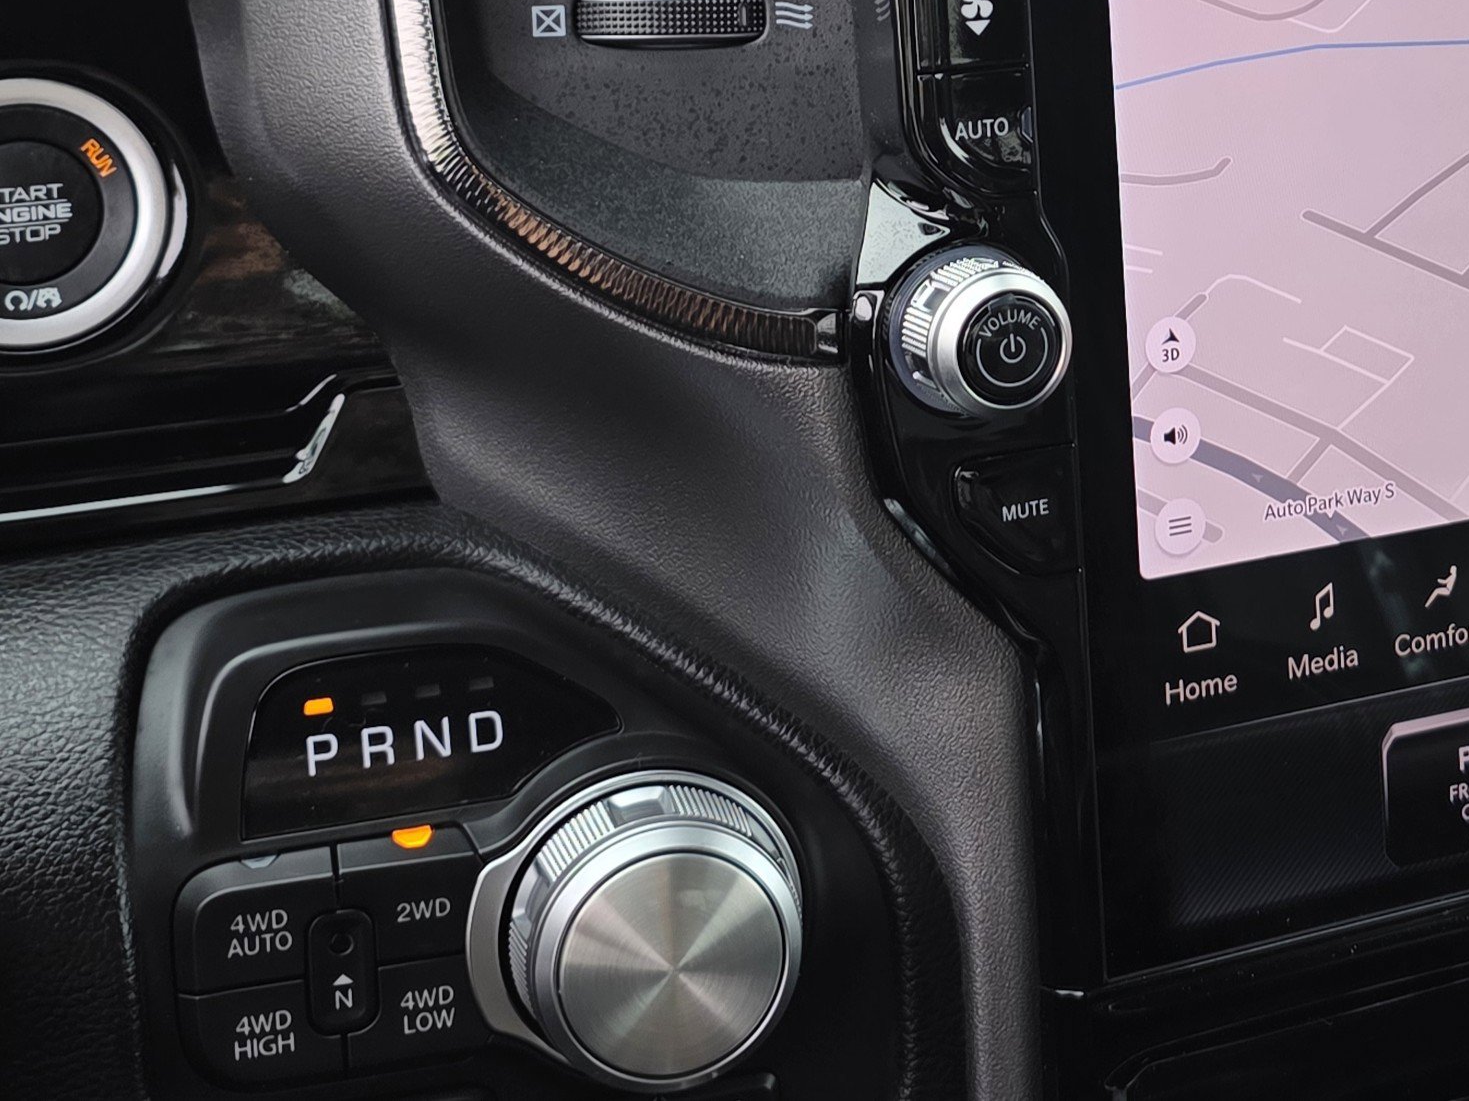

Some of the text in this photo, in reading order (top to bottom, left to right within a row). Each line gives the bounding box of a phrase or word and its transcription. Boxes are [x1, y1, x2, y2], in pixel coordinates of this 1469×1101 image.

[955, 116, 1009, 141] AUTO
[80, 138, 117, 178] RUN
[0, 183, 63, 203] TART
[0, 202, 73, 223] NGINE
[0, 224, 61, 246] STOP
[978, 308, 1041, 339] VOLUME
[1161, 347, 1180, 363] 3D
[1002, 498, 1049, 522] MUTE
[1264, 484, 1395, 521] Auto Park Way S
[1287, 645, 1359, 680] Media
[1165, 673, 1238, 706] Home
[230, 909, 289, 934] 4WD
[396, 897, 452, 923] 2WD
[227, 931, 293, 959] AUTO
[334, 988, 354, 1009] N
[400, 985, 455, 1010] 4WD
[235, 1009, 292, 1036] 4WD
[403, 1008, 456, 1035] LOW
[234, 1032, 296, 1061] HIGH
